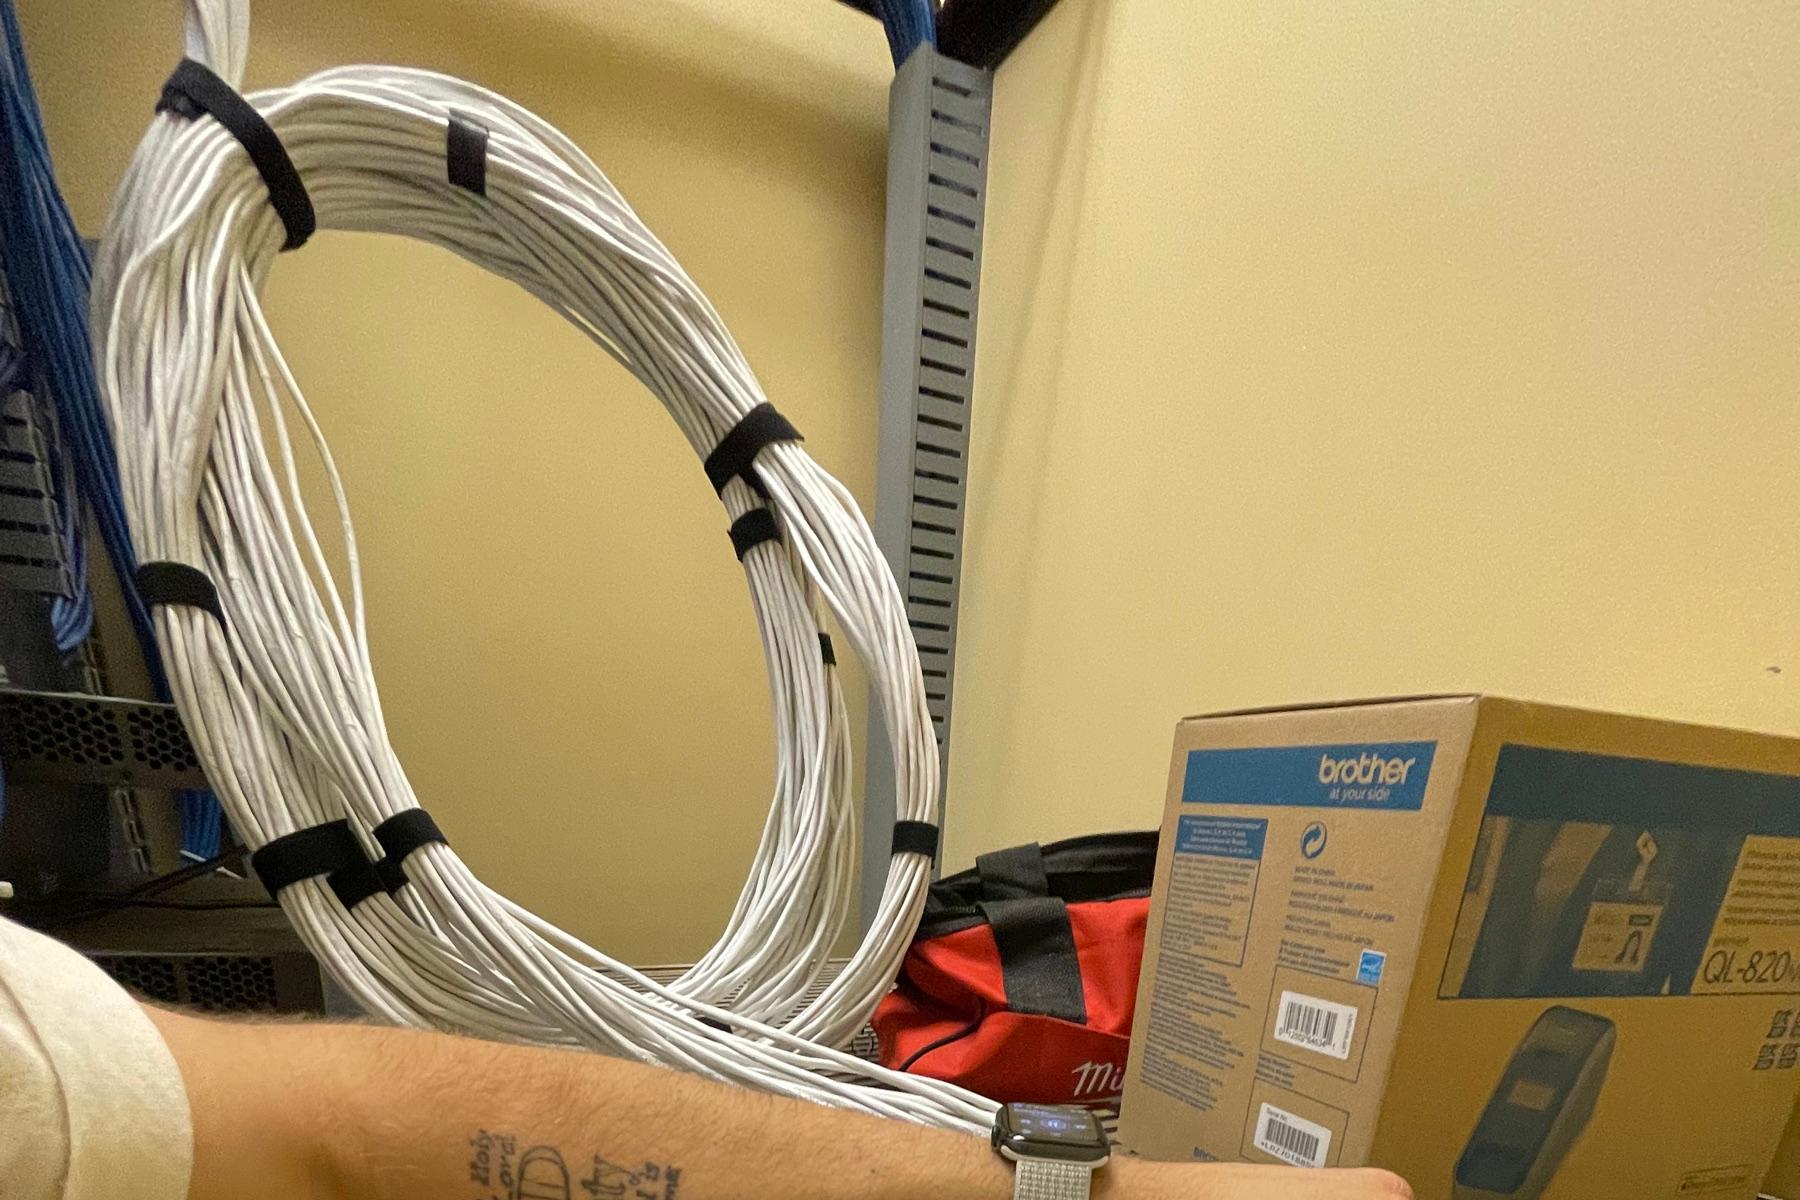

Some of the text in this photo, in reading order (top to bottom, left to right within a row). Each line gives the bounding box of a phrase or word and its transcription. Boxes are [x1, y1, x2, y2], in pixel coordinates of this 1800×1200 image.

[1318, 752, 1416, 785] brother
[1329, 786, 1341, 800] at
[1341, 787, 1366, 804] your
[470, 1129, 495, 1186] Holy
